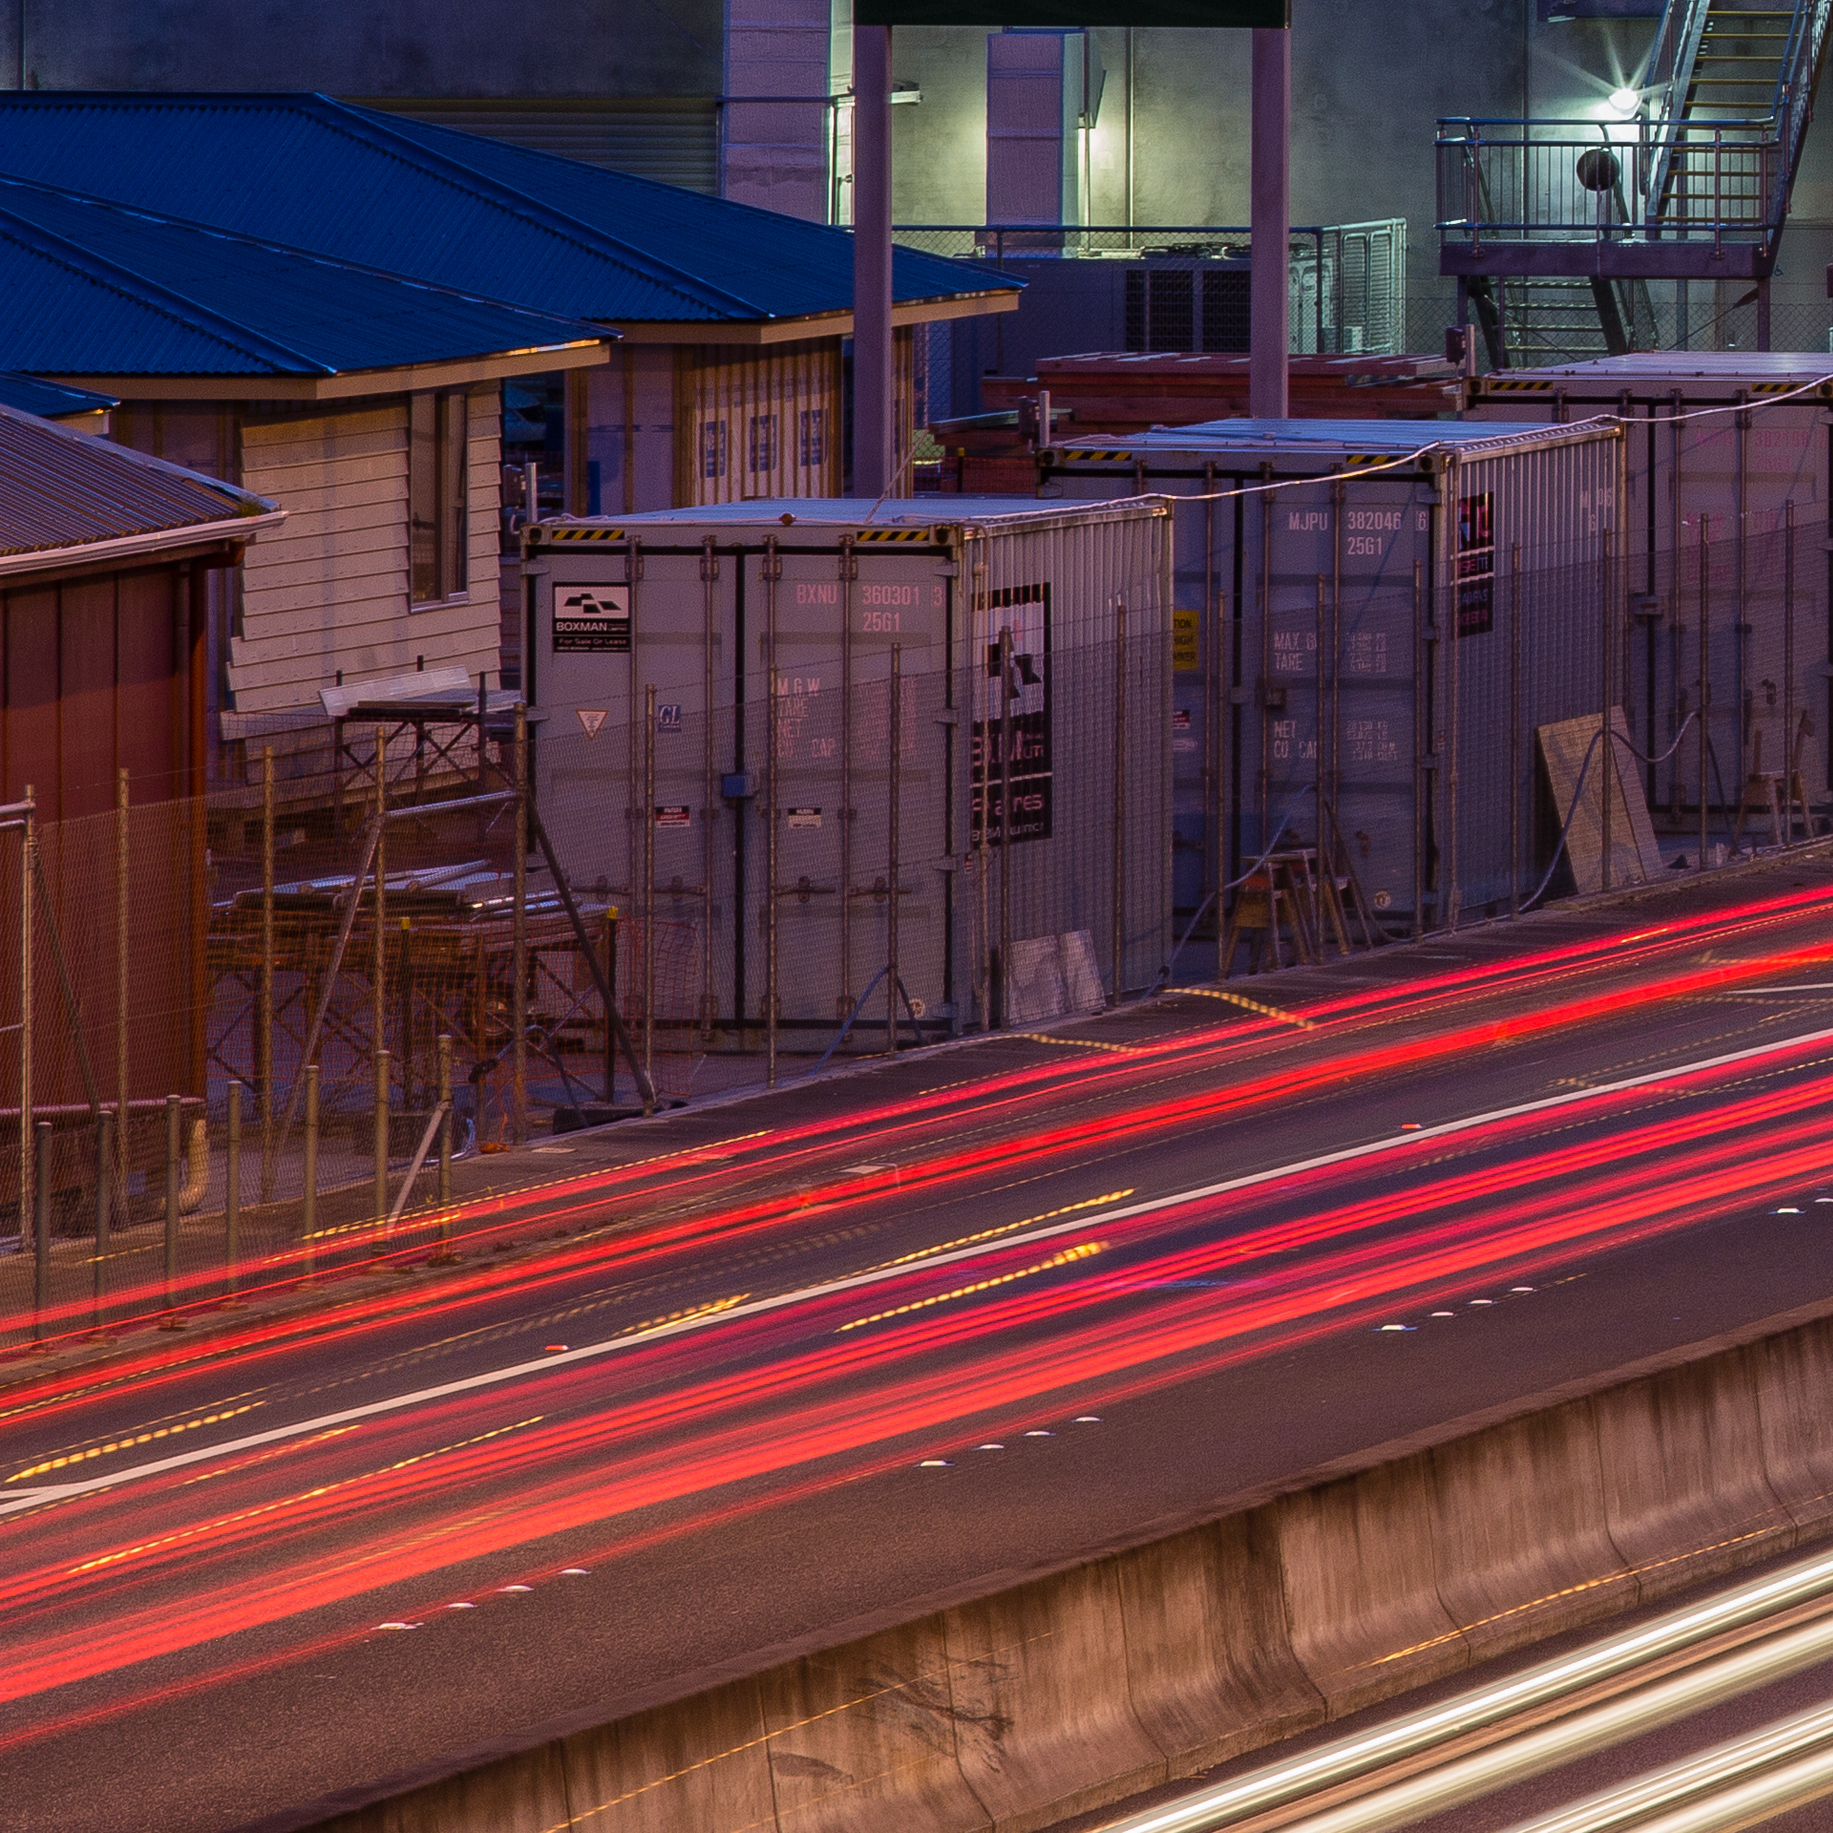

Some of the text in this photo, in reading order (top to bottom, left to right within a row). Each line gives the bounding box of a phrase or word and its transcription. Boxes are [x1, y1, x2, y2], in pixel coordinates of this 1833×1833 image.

[1288, 512, 1328, 531] MJPU
[1347, 512, 1401, 531] 382046
[1347, 537, 1383, 555] 25G1
[797, 584, 943, 607] BXNU 360301 3
[556, 622, 608, 632] BOXMAN
[862, 612, 901, 632] 25G1
[659, 705, 681, 725] GL
